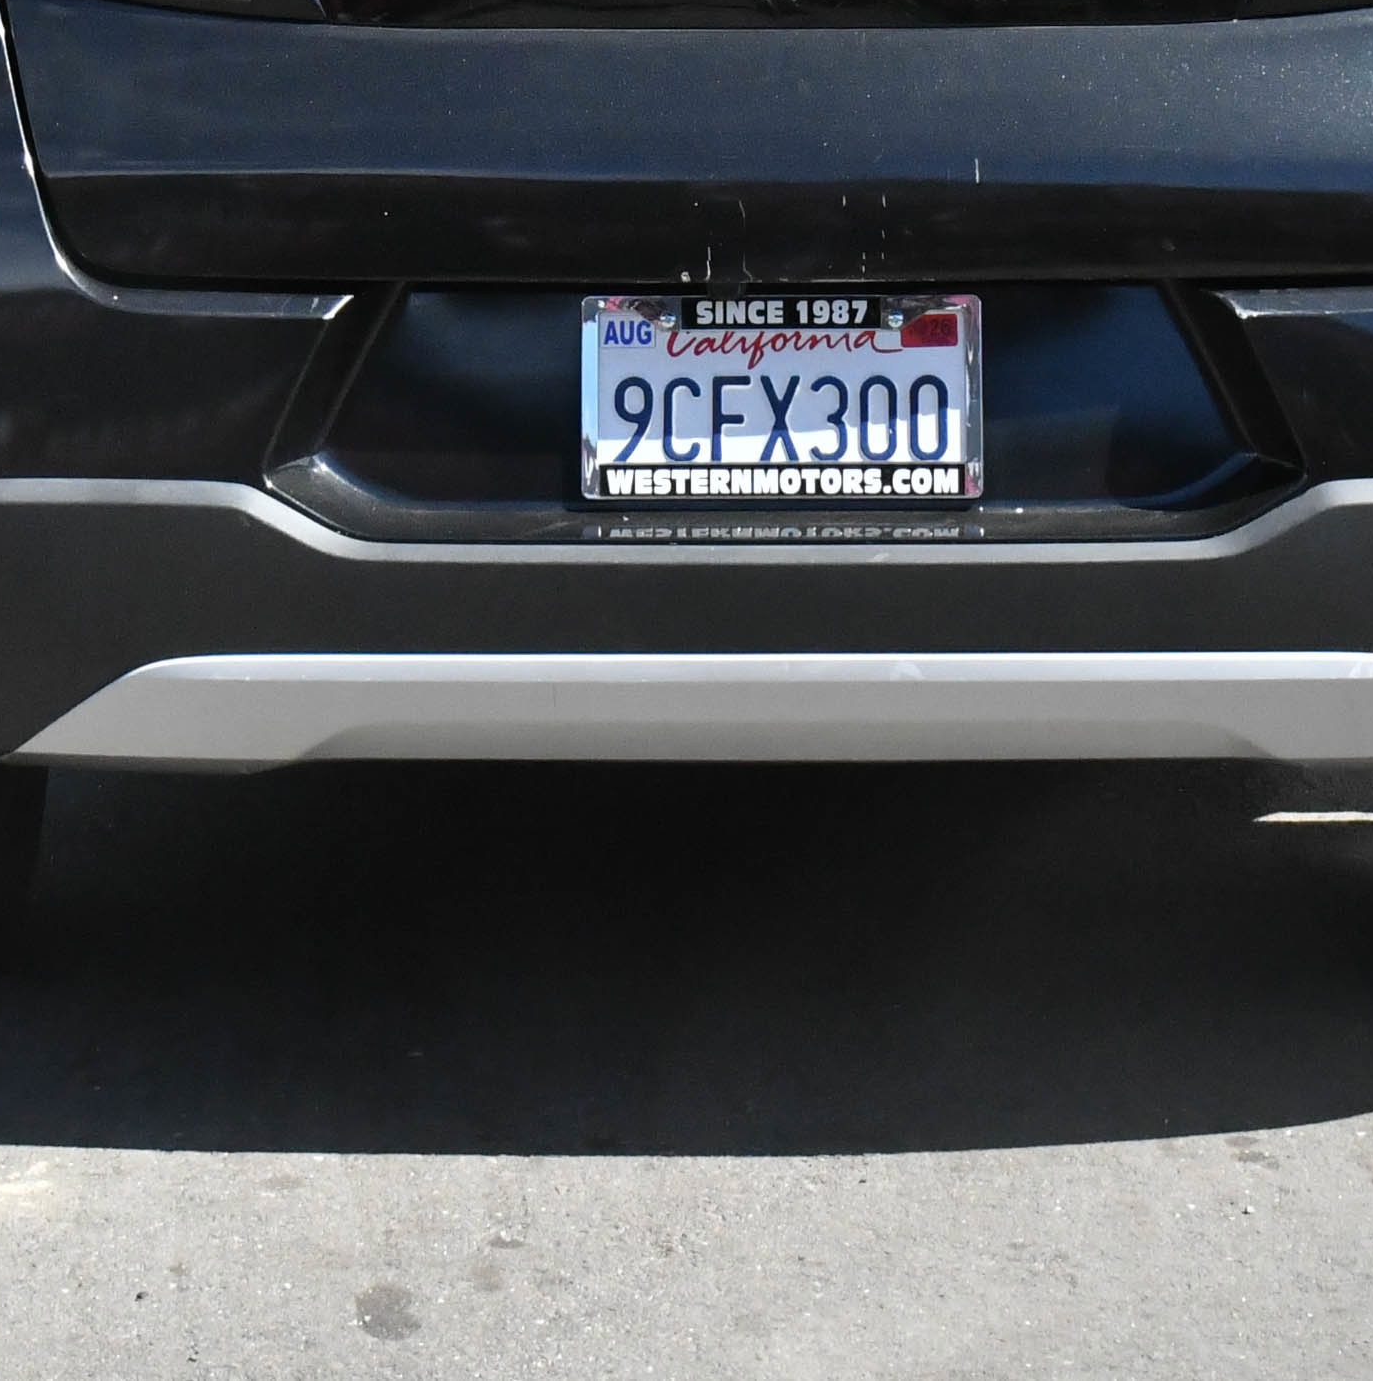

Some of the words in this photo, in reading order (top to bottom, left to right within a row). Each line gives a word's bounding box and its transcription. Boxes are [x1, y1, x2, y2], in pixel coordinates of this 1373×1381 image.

[696, 300, 784, 325] SINCE
[796, 300, 868, 325] 1987
[603, 320, 652, 345] AUG
[613, 374, 949, 462] 9CFX300
[606, 467, 959, 495] WESTERNMOTORS.COM
